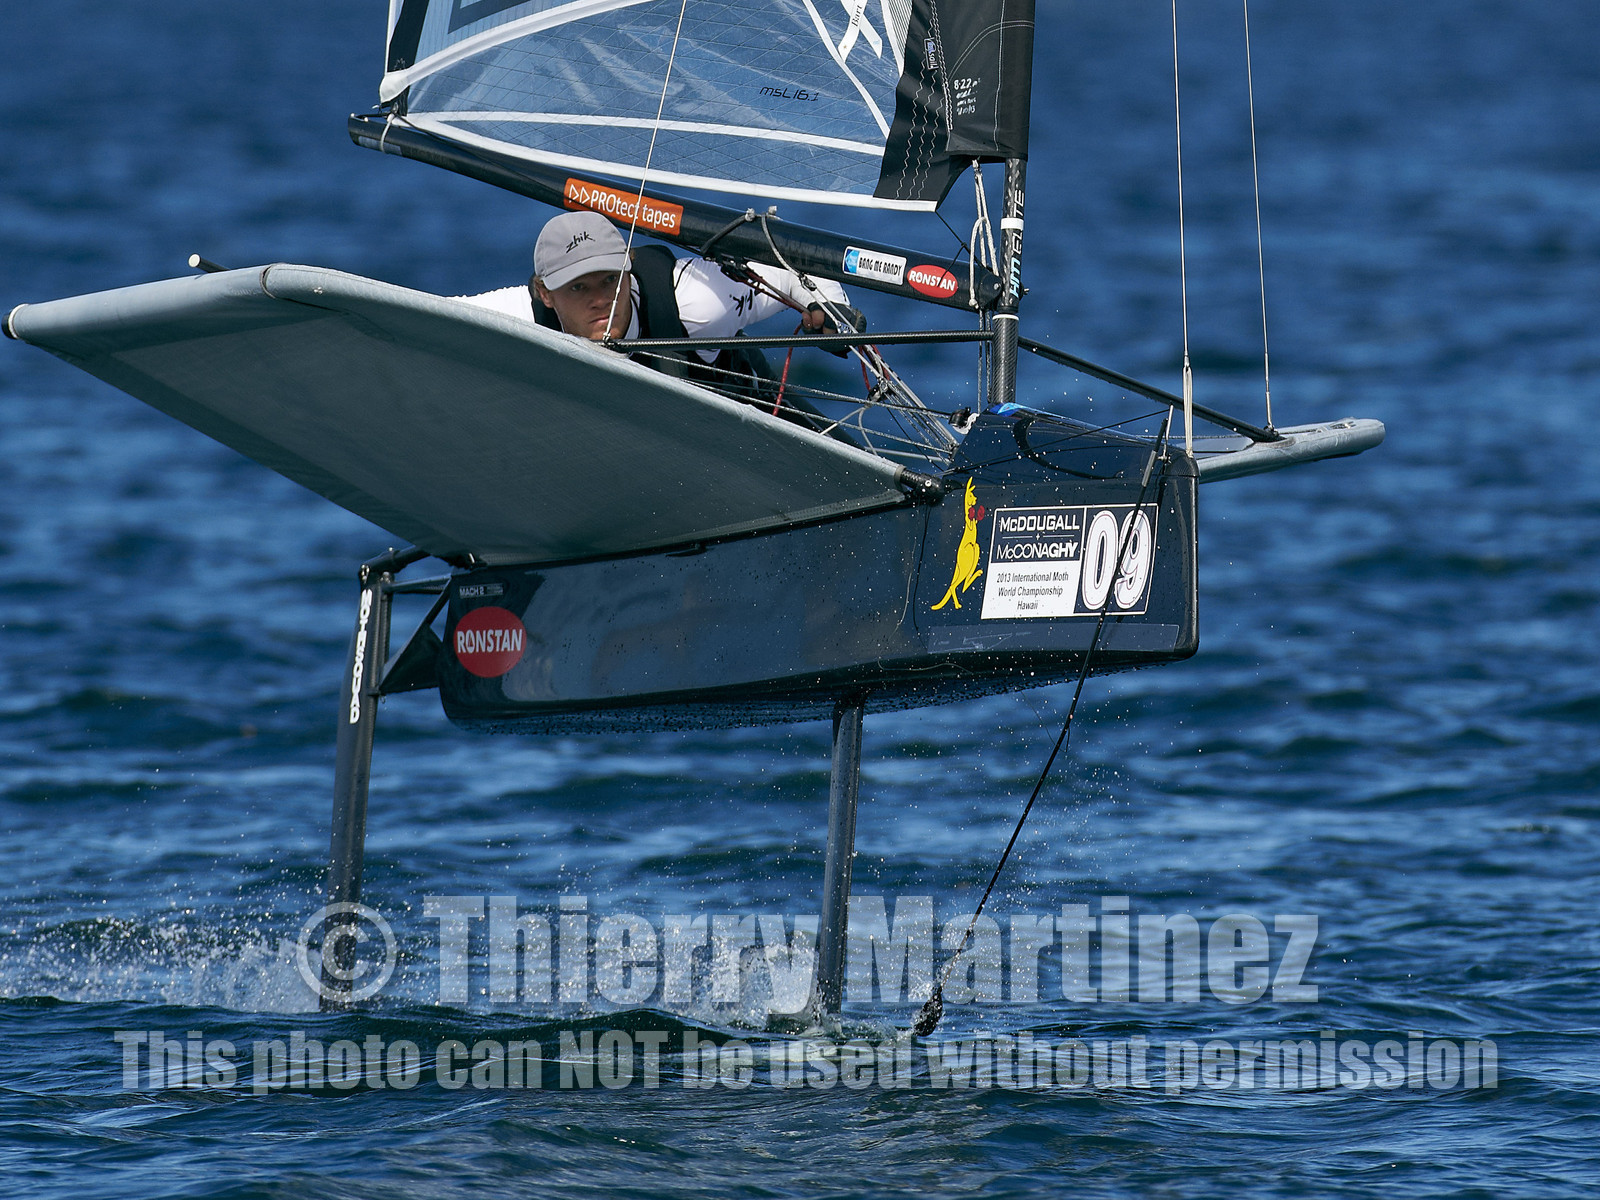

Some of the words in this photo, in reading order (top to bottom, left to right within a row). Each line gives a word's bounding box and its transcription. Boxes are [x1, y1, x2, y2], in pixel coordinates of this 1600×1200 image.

[851, 4, 862, 27] Bart
[590, 189, 639, 220] PROtect
[642, 203, 676, 228] tapes
[1012, 189, 1025, 254] ELTE
[565, 231, 595, 254] zhik
[858, 257, 873, 271] BANG
[873, 259, 883, 273] ME
[909, 270, 956, 291] RONSTAN
[999, 514, 1080, 532] McDOUGALL
[996, 541, 1079, 560] McCONAGHY
[1082, 509, 1152, 610] 09
[996, 573, 1011, 583] 2013
[1012, 572, 1052, 583] International
[1052, 571, 1069, 582] Moth
[459, 587, 479, 597] MACH
[998, 586, 1016, 597] World
[1017, 585, 1063, 598] Championship
[1016, 600, 1039, 610] Hawaii
[457, 629, 522, 654] RONSTAN
